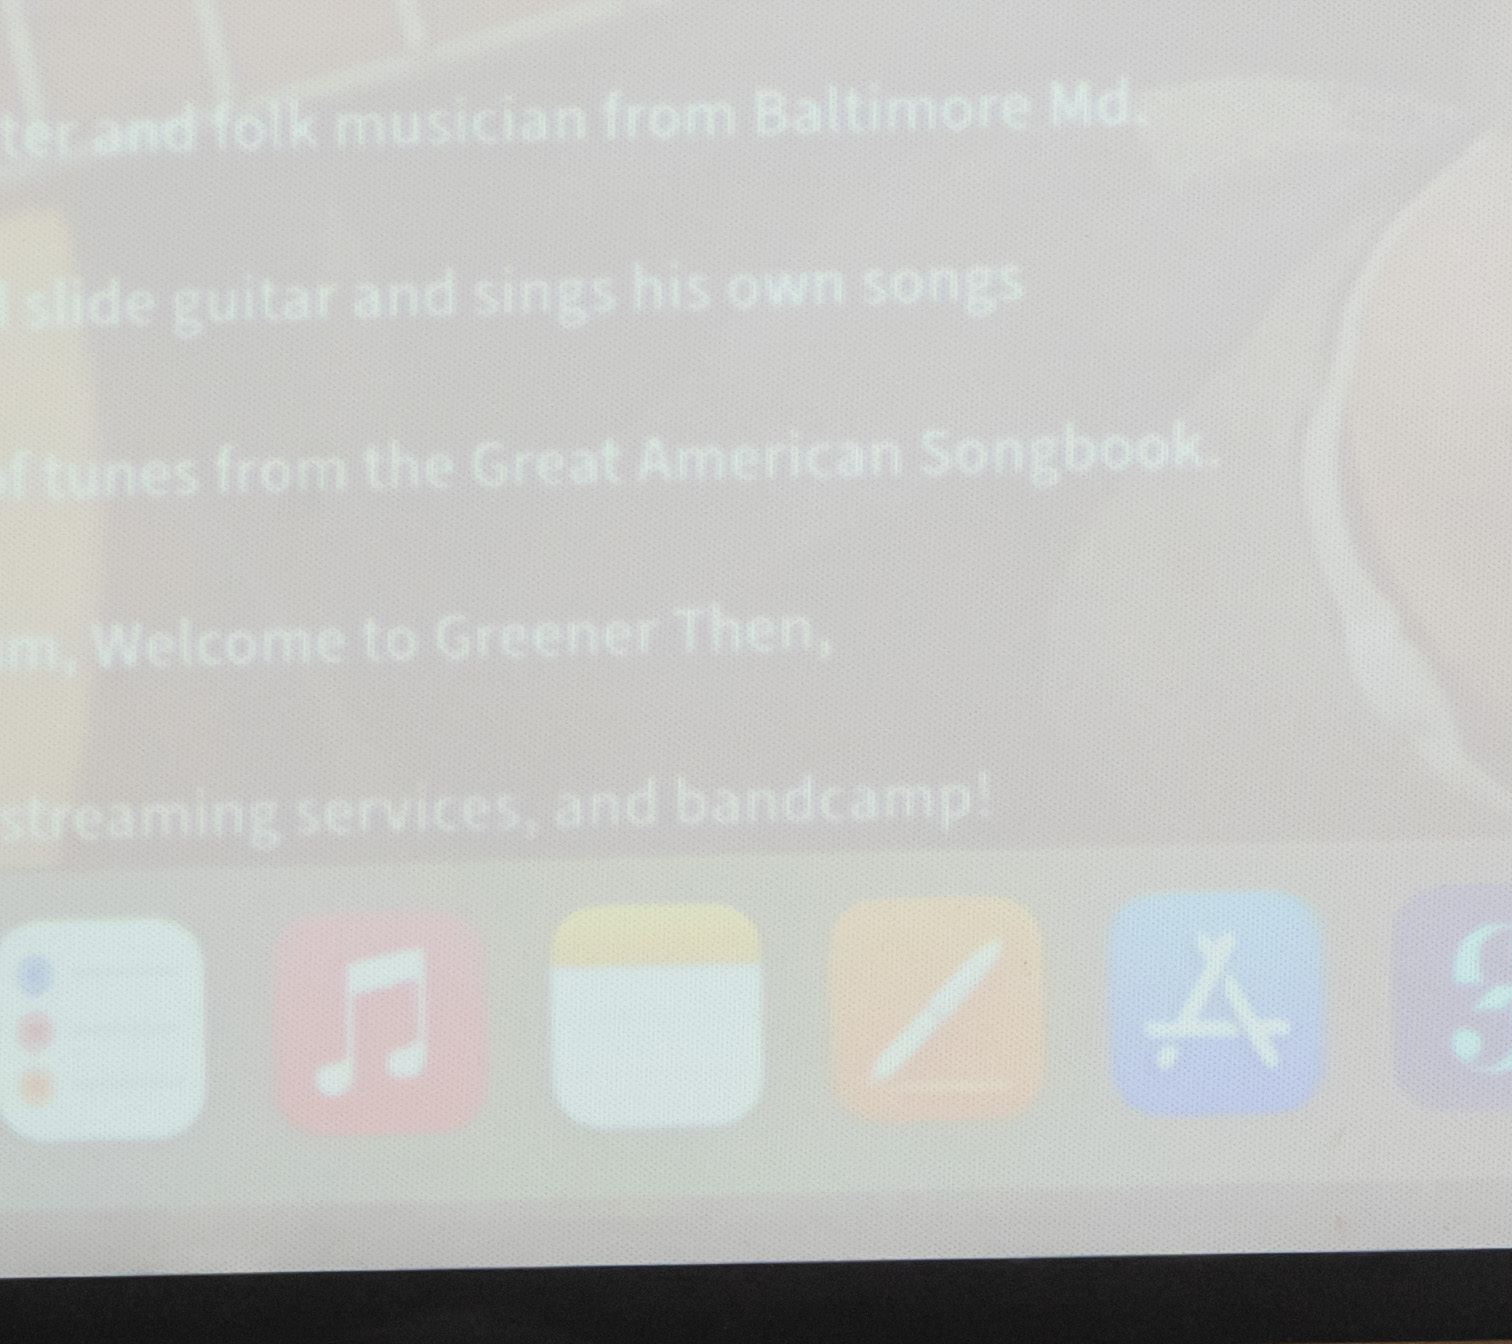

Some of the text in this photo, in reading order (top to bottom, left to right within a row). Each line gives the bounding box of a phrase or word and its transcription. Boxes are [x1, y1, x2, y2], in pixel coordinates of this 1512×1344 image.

[92, 100, 200, 157] and
[214, 98, 318, 153] folk
[334, 94, 588, 148] musician
[603, 88, 736, 143] from
[753, 82, 1033, 138] Baltimore
[1049, 77, 1148, 129] Md.
[24, 278, 156, 330] slide
[172, 272, 338, 341] guitar
[352, 268, 457, 319] and
[473, 263, 618, 330] sings
[632, 259, 712, 314] his
[726, 268, 846, 311] own
[862, 262, 1026, 320] songs
[43, 451, 200, 502] tunes
[215, 443, 348, 496] from
[362, 439, 456, 491] the
[470, 436, 623, 488] Great
[637, 429, 903, 485] American
[920, 419, 1221, 489] Songbook.
[89, 616, 347, 672] Welcome
[360, 616, 420, 665] to
[433, 611, 660, 663] Greener
[674, 602, 834, 662] Then,
[0, 769, 992, 850] streaming services, and bandcamp!
